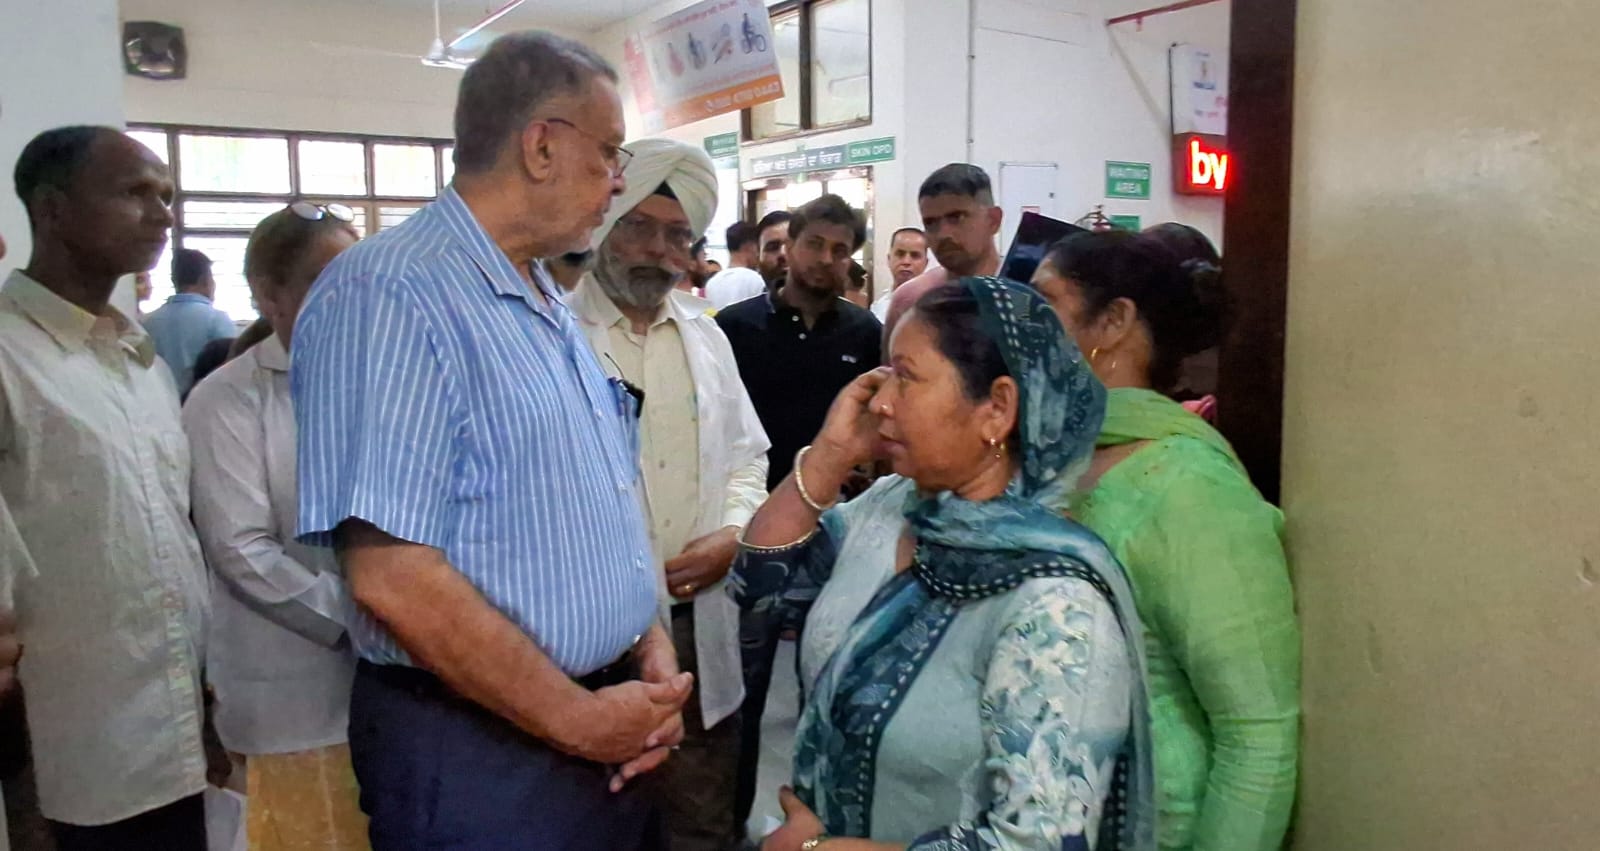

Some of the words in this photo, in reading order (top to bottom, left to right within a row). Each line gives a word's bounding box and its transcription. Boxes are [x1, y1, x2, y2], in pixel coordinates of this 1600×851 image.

[851, 147, 871, 158] SKIN
[872, 144, 893, 155] OPD
[1191, 141, 1227, 190] by
[1110, 167, 1149, 179] WAITING
[1114, 182, 1142, 193] AREA
